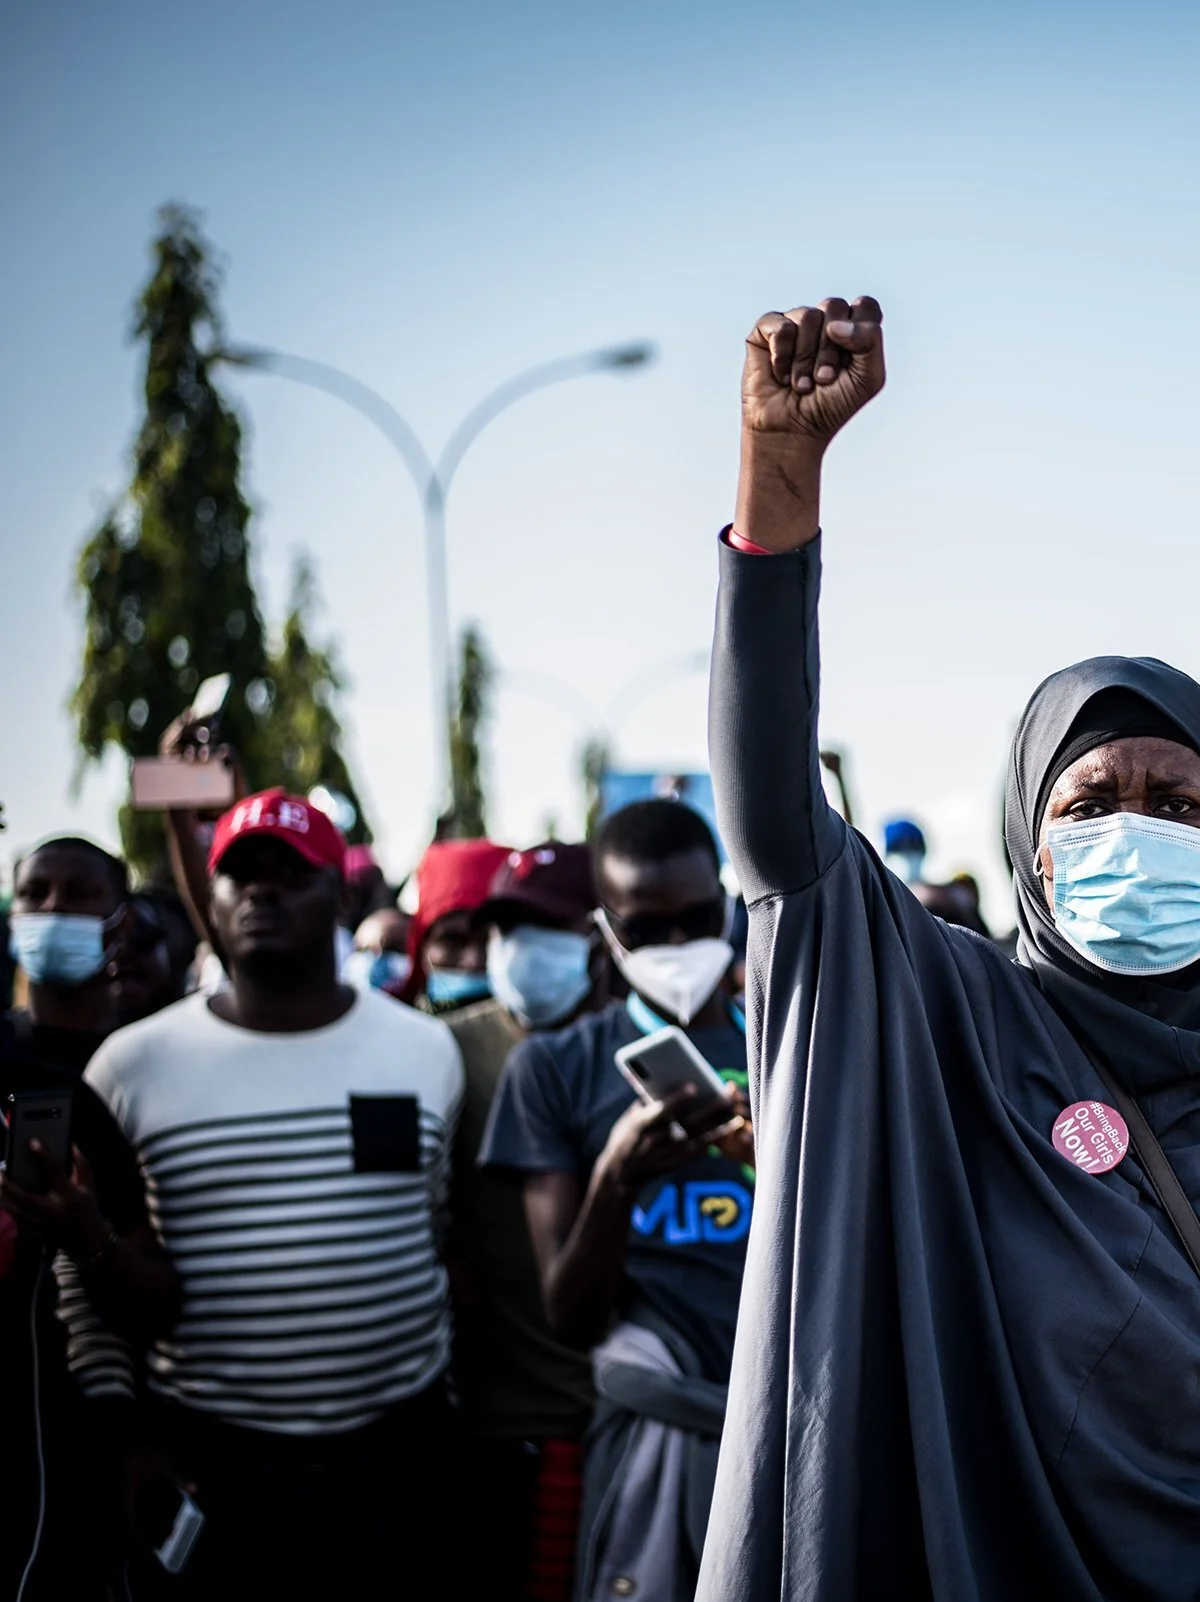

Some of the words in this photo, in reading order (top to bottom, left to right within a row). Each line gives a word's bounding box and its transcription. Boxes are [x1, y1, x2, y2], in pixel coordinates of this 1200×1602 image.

[1075, 1107, 1095, 1131] Our
[1091, 1133, 1114, 1164] Girls
[1090, 1102, 1126, 1154] #BringBack
